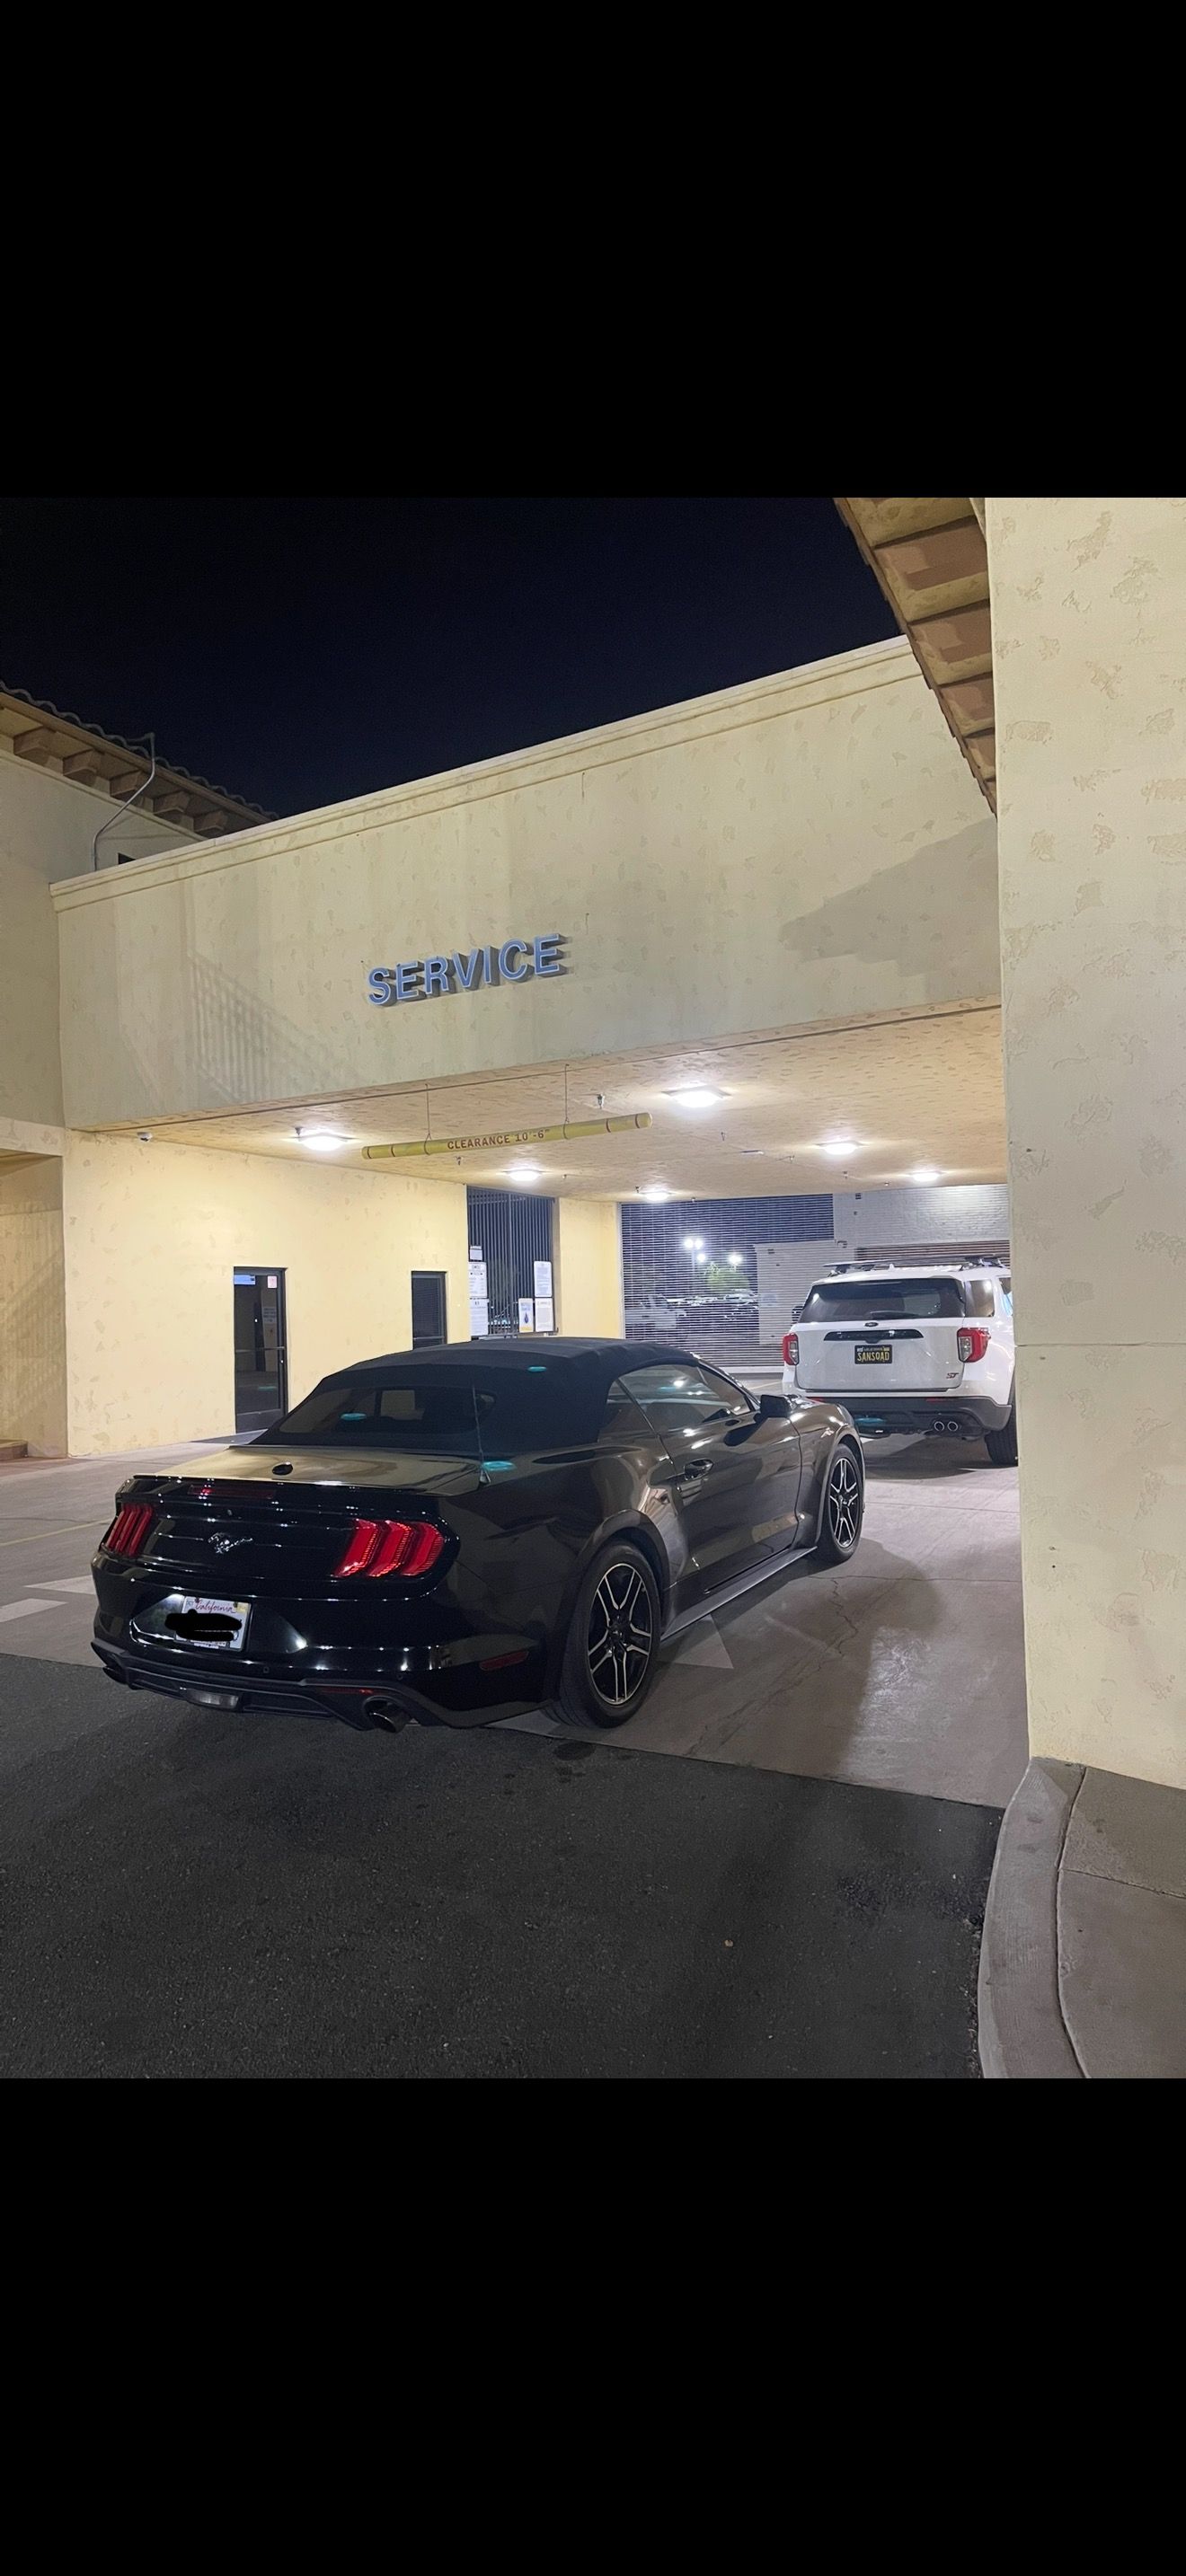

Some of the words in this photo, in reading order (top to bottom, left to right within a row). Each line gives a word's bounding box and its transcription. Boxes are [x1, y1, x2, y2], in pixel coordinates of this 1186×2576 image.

[368, 933, 562, 1005] SERVICE
[447, 1134, 510, 1150] CLEARANCE
[195, 1600, 236, 1614] California
